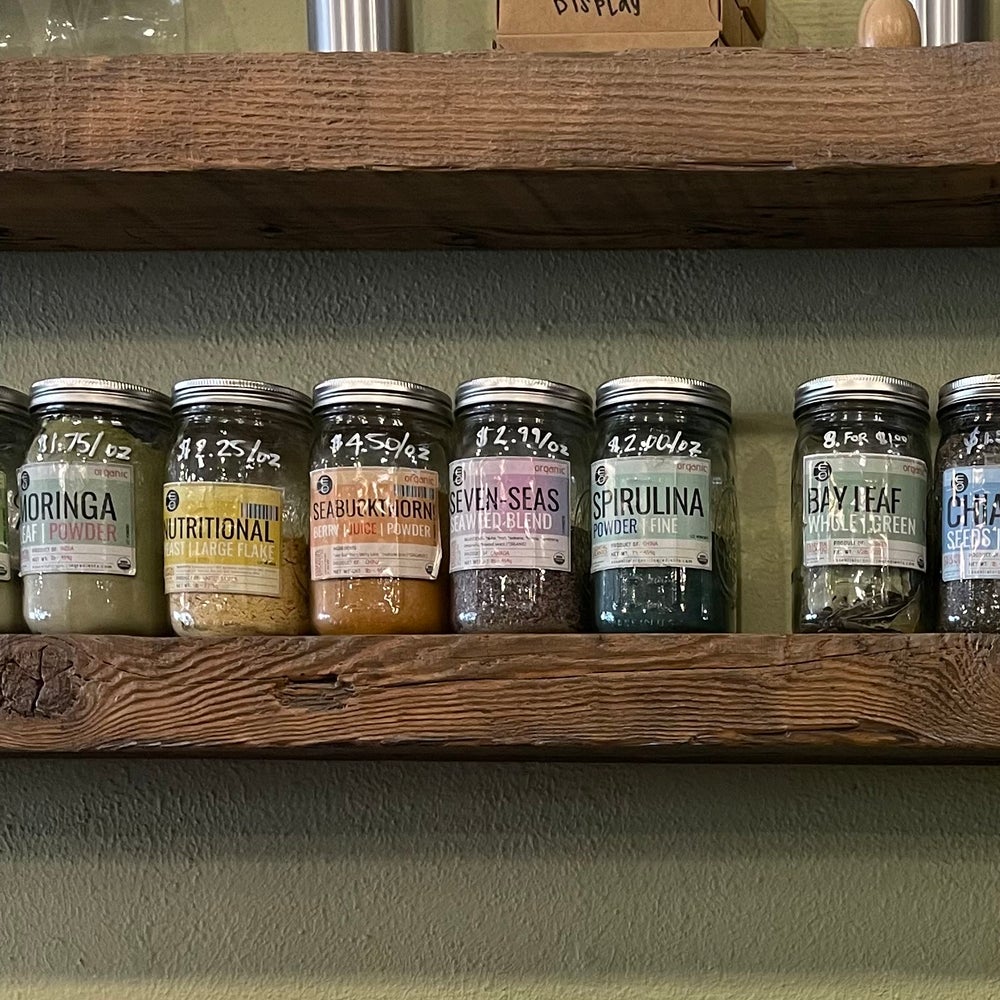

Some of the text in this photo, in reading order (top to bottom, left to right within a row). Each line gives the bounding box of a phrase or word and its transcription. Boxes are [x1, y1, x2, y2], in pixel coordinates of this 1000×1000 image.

[95, 467, 128, 478] organic
[535, 464, 565, 473] organic
[677, 463, 708, 473] organic
[405, 474, 434, 485] organic
[451, 487, 560, 514] SEVEN-SEAS
[593, 487, 704, 520] SPIRULINA
[808, 486, 847, 514] BAY
[314, 523, 430, 538] BERRY JUICE POWDER
[451, 513, 552, 532] SEAWEED BLEND
[594, 518, 678, 538] POWDER FINE
[808, 516, 916, 535] WHOLE GREEN
[50, 523, 117, 541] POWDER
[947, 528, 991, 549] SEEDS
[196, 542, 275, 559] LARGE FLAKE
